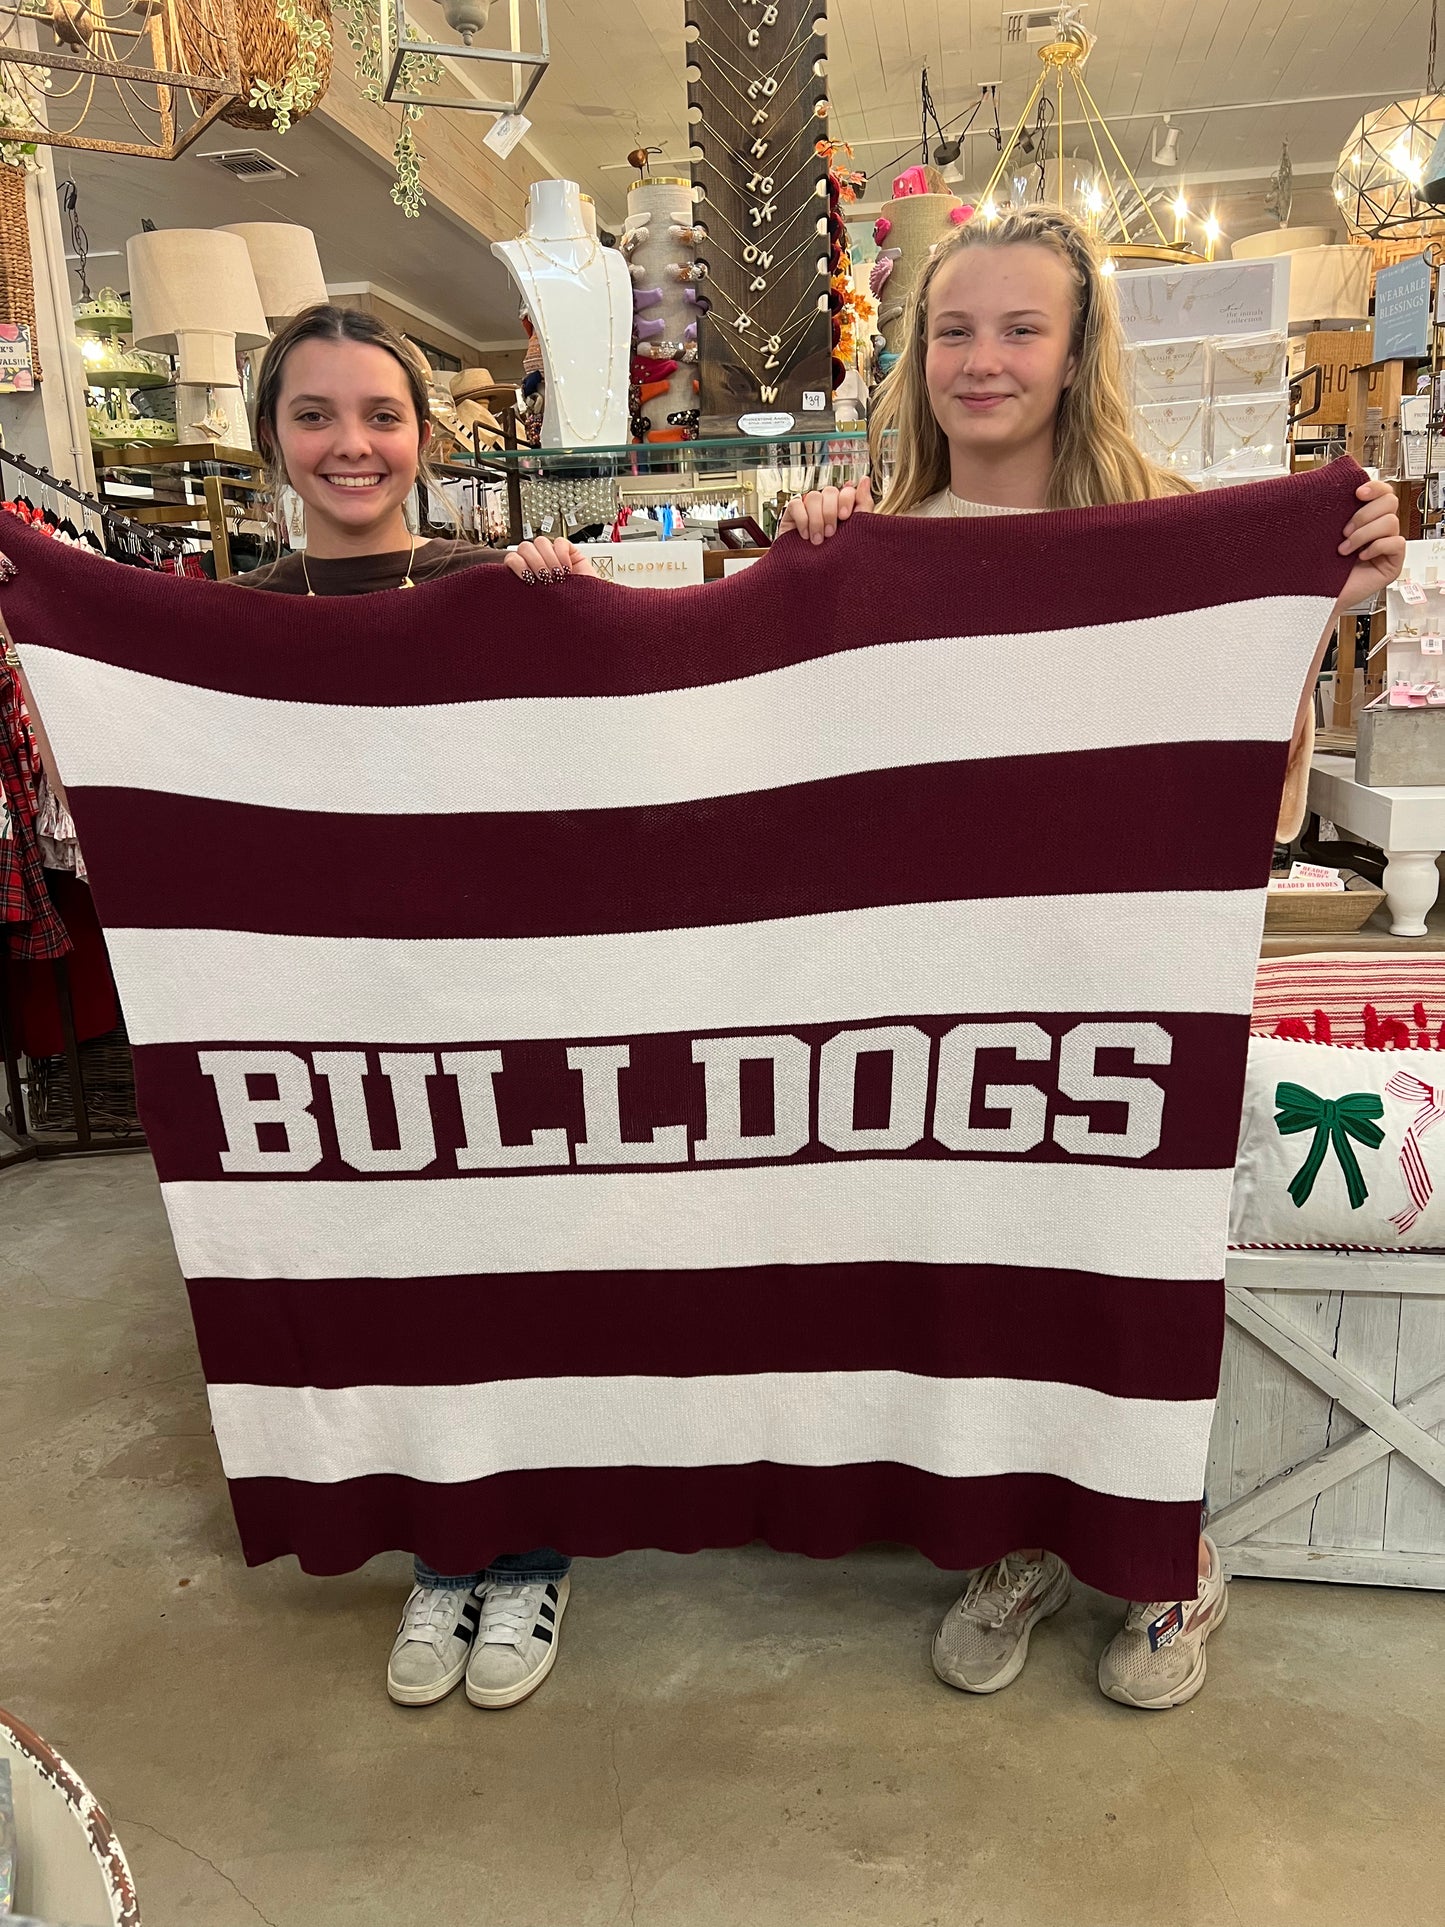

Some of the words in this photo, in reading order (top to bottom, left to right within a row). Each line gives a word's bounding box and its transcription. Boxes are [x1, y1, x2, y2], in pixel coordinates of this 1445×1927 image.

[763, 4, 779, 26] B
[747, 29, 759, 47] C
[751, 109, 769, 125] F
[750, 138, 768, 159] H
[750, 276, 766, 292] P
[1379, 277, 1427, 303] WEARABLE
[1379, 294, 1424, 320] BLESSINGS
[734, 313, 751, 334] R
[768, 335, 782, 354] S
[760, 385, 779, 404] W
[617, 561, 688, 573] MCDOWELL
[197, 1021, 1173, 1174] BULLDOGS
